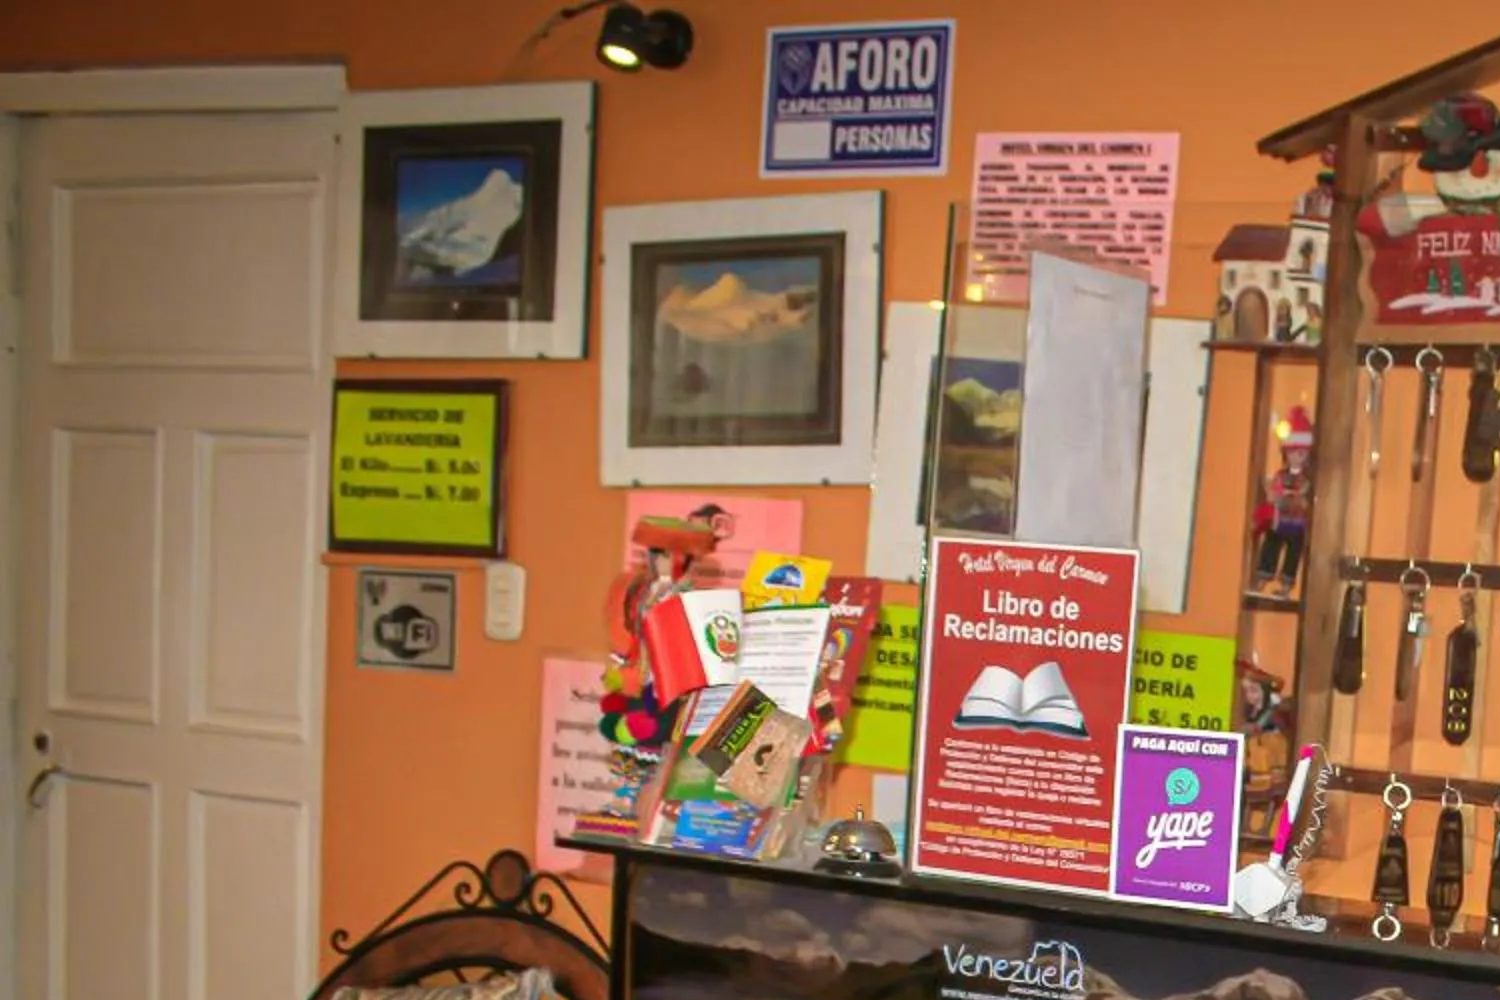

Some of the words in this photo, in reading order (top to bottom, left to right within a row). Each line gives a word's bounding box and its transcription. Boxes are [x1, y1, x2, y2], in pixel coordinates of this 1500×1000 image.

[811, 36, 938, 93] AFORO
[835, 124, 932, 153] PERSONAS
[1416, 230, 1471, 257] FELIZ
[983, 589, 1043, 617] Libro
[1050, 596, 1080, 620] de
[943, 614, 1124, 653] Reclamaciones
[1171, 653, 1198, 670] DE
[1132, 736, 1166, 751] PAGA
[1201, 741, 1229, 756] CON
[1135, 811, 1215, 869] yape
[943, 940, 1084, 991] Venezuela
